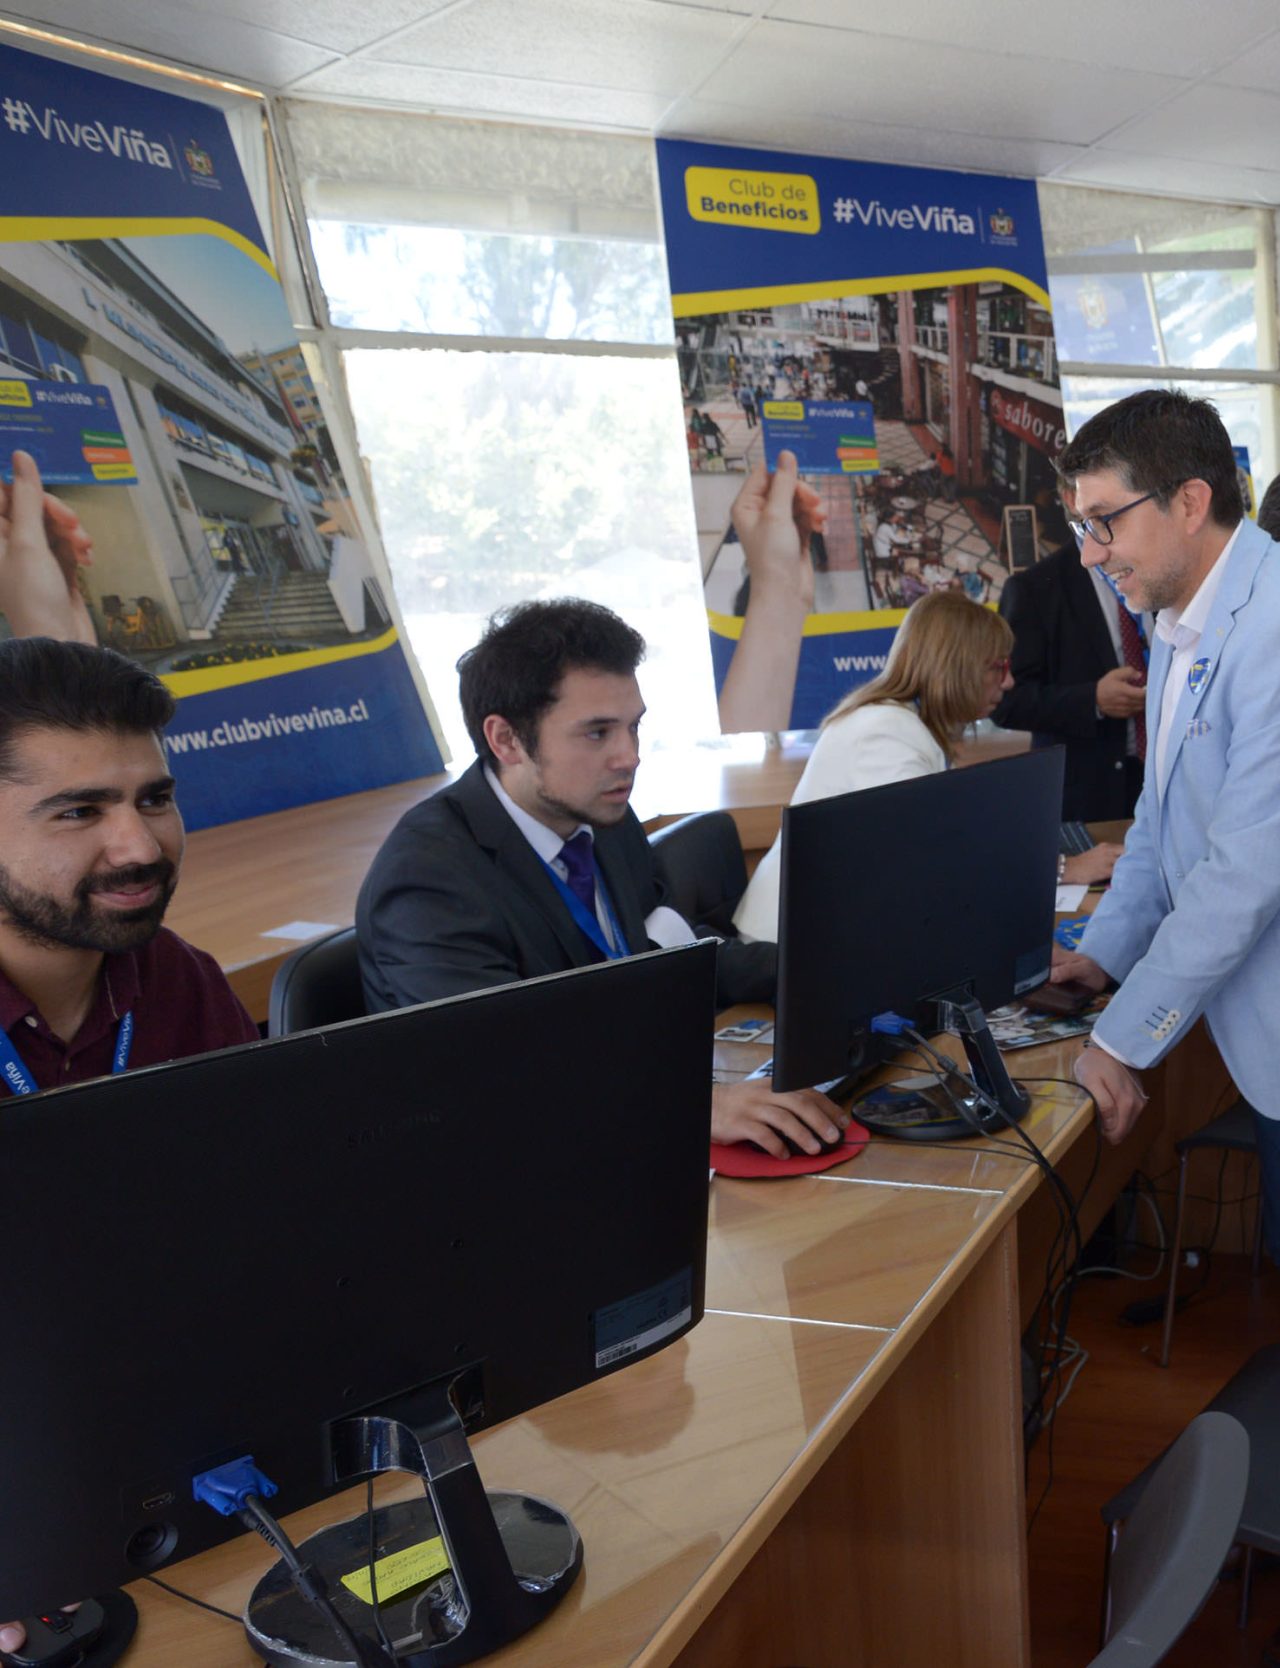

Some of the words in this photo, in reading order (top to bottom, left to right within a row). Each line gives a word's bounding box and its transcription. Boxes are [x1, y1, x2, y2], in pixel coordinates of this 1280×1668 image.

[2, 97, 173, 169] #ViveViña
[729, 178, 775, 199] Club
[781, 180, 806, 200] de
[701, 196, 808, 221] Beneficios
[833, 197, 974, 235] #ViveViña
[165, 699, 369, 754] ww.clubvivevina.cl
